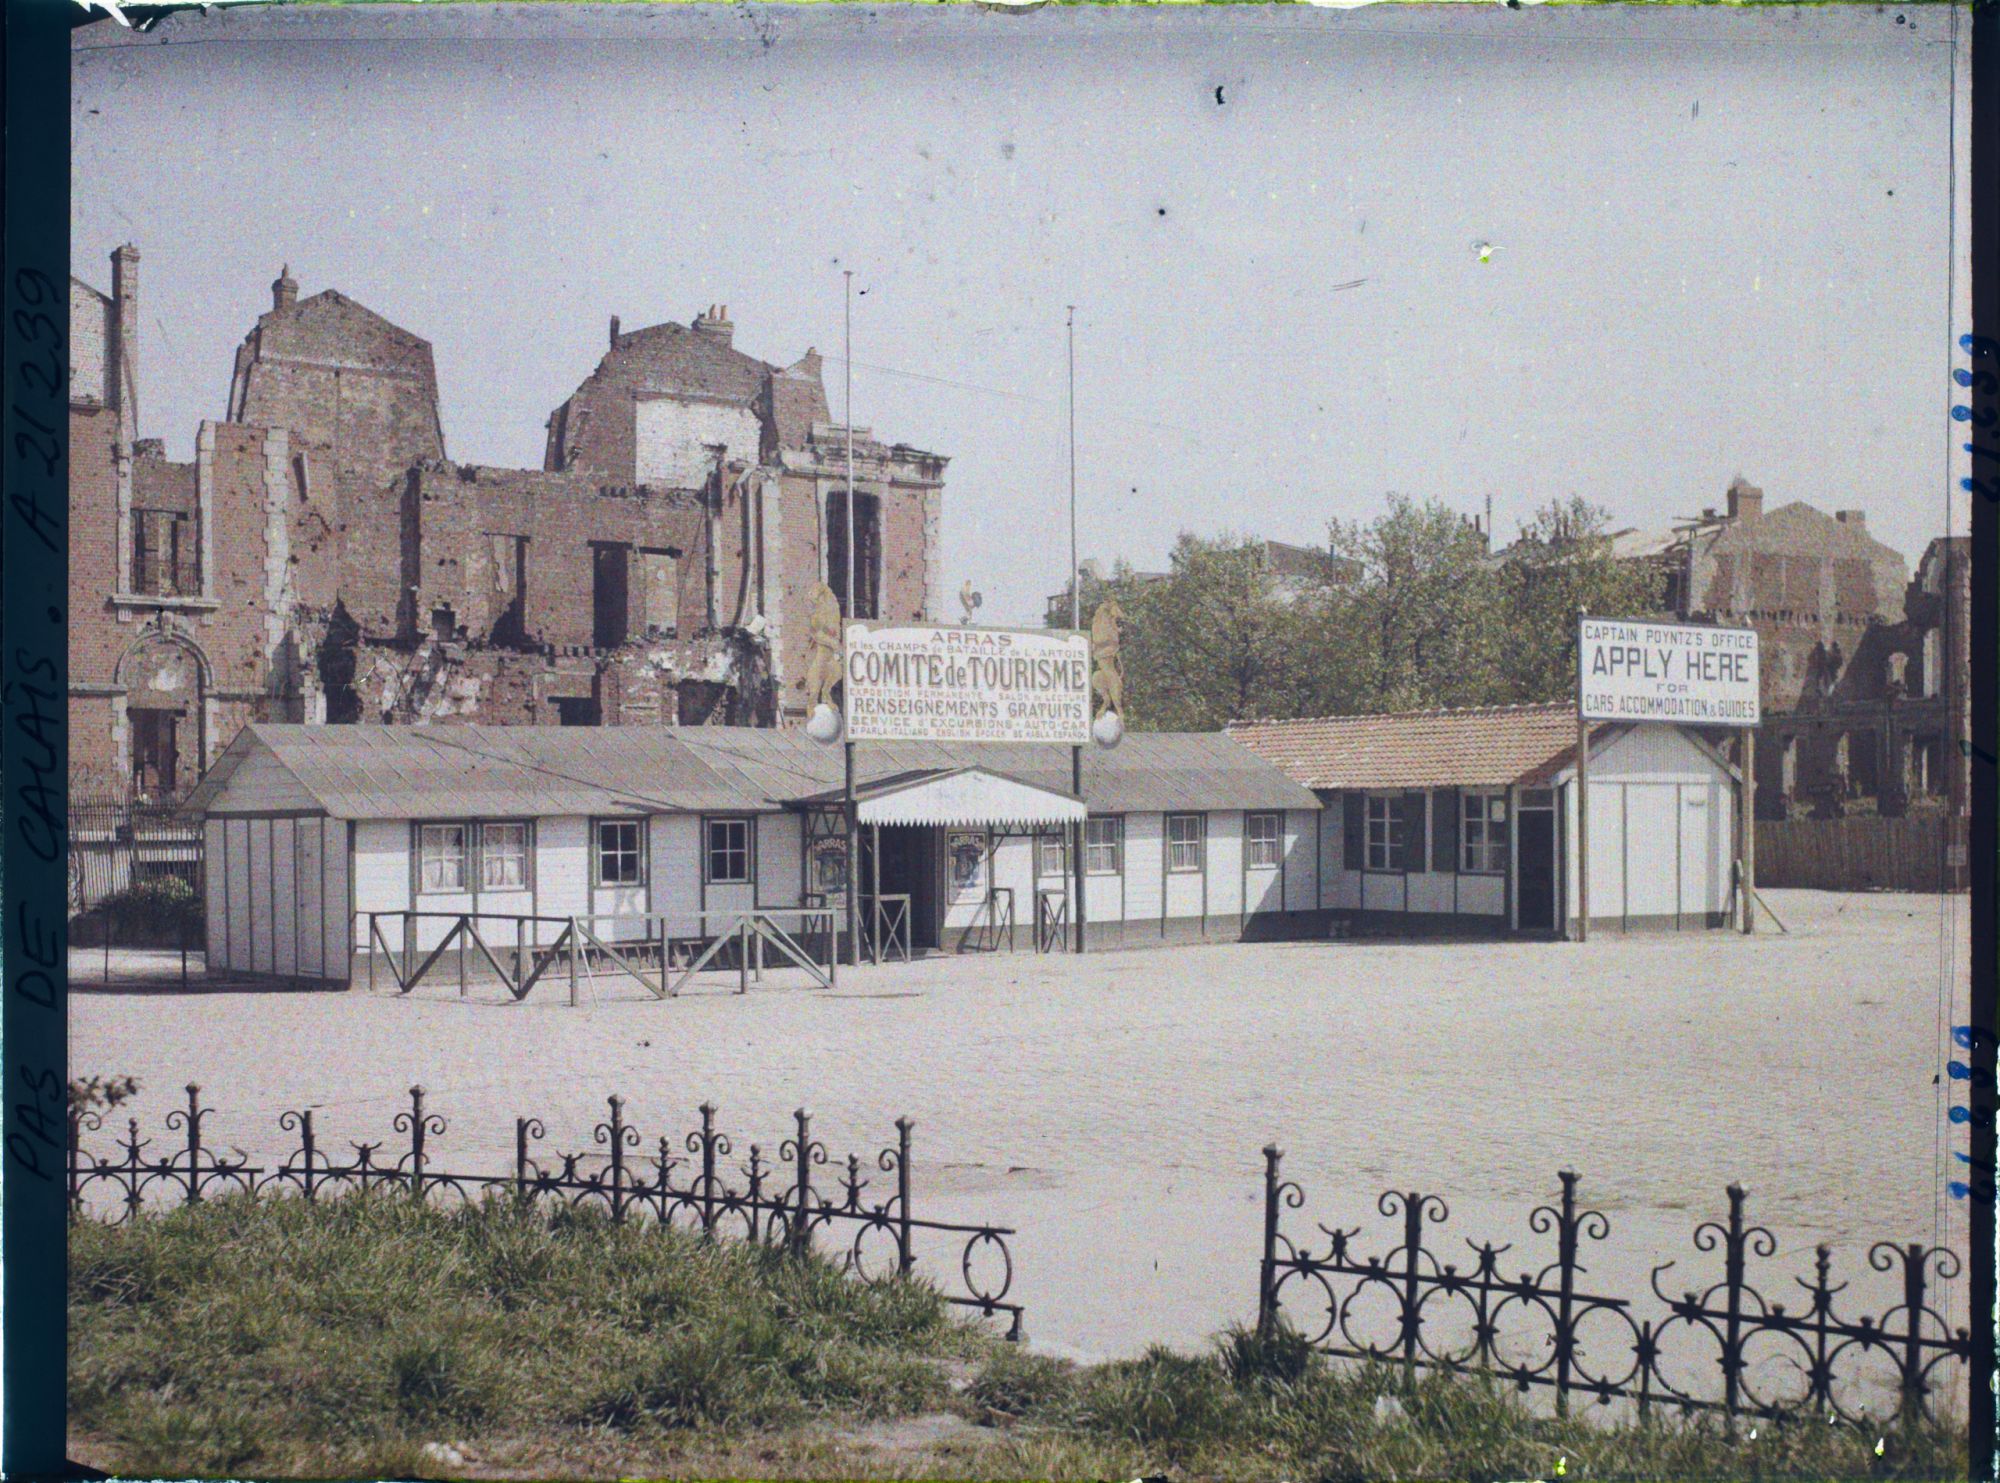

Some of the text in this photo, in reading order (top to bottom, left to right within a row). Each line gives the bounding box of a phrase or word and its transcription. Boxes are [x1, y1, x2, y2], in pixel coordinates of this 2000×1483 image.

[930, 630, 1013, 647] ARRAS
[1585, 625, 1753, 649] CAPTAIN POYNTZ'S OFFICE
[878, 641, 928, 652] CHAMPS
[947, 644, 1006, 657] BATAILLE
[945, 655, 967, 688] de
[967, 656, 1086, 691] TOURISME
[1592, 645, 1749, 682] APPLY HERE
[1656, 682, 1689, 694] FOR
[854, 697, 1083, 719] RENSEIGNEMENTS GRATUITS
[1619, 695, 1708, 716] ACCOMMODATION
[1719, 699, 1755, 718] GUIDES
[851, 715, 911, 728] SERVICE
[15, 901, 60, 1011] DE
[7, 1064, 61, 1182] PAS
